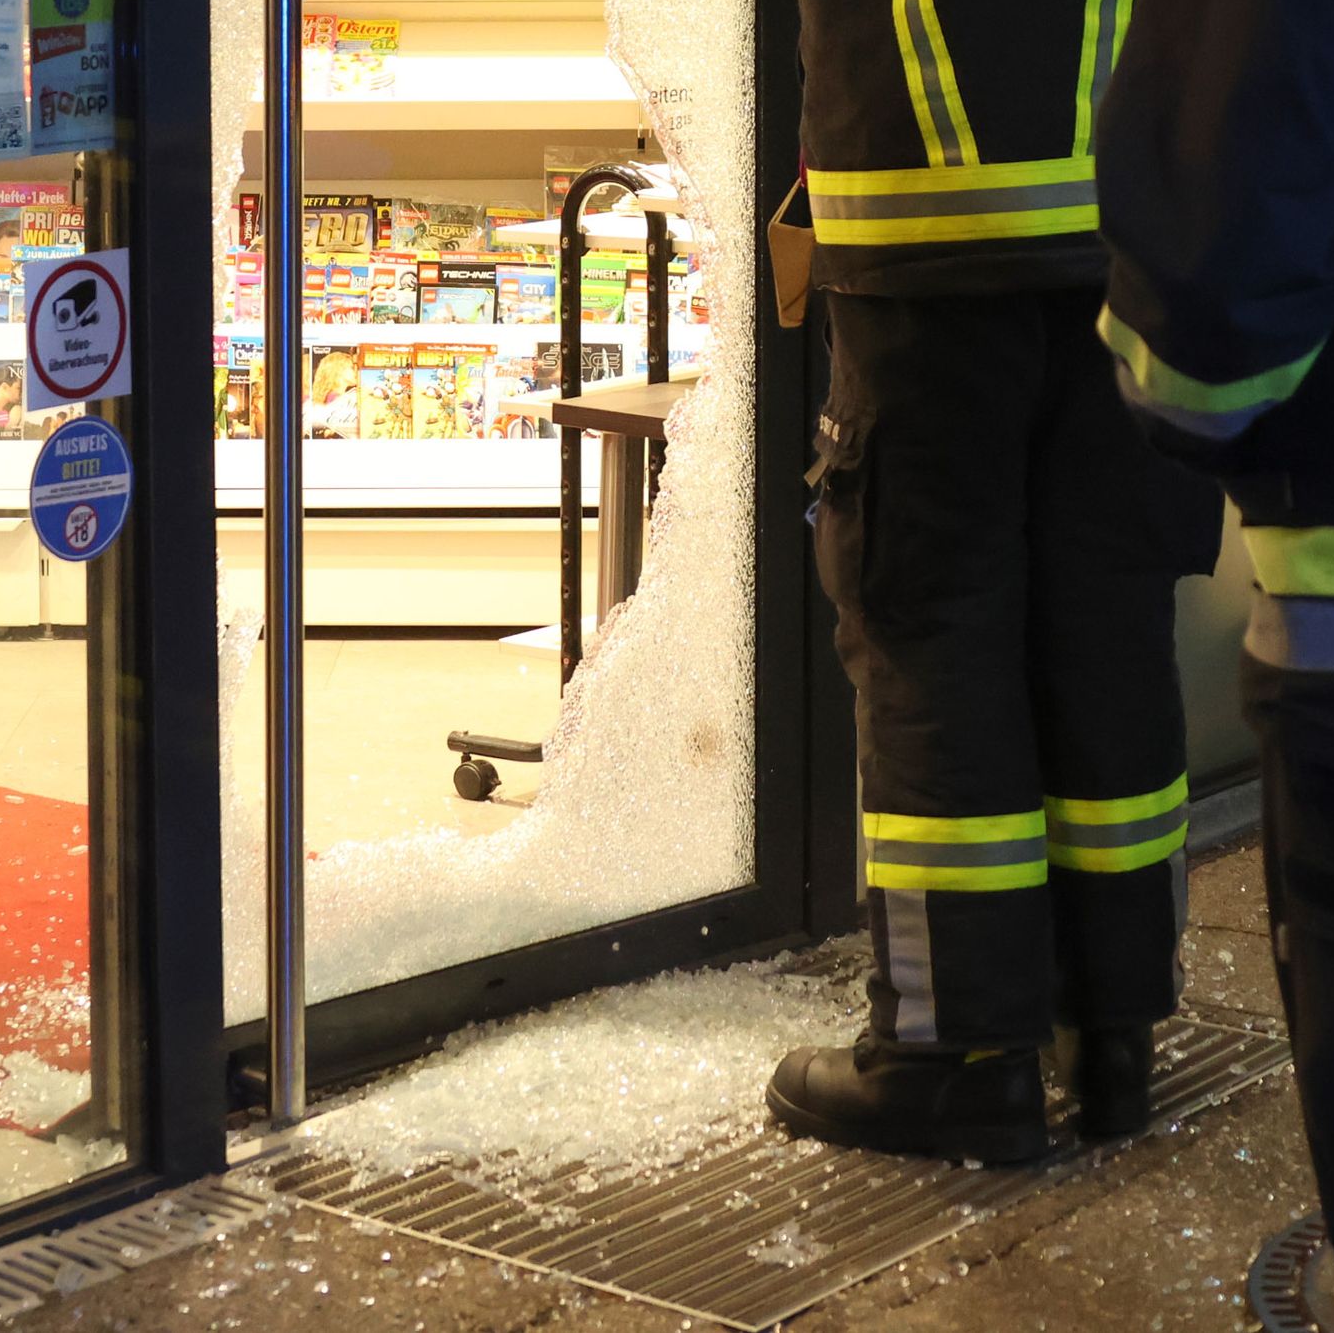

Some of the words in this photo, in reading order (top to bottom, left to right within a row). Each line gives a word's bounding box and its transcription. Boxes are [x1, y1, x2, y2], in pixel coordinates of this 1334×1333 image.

[337, 21, 396, 35] Ostern
[372, 40, 395, 50] 214
[80, 54, 110, 71] BON
[74, 94, 109, 118] APP
[326, 196, 346, 207] NR.
[345, 196, 354, 206] 7
[441, 269, 497, 281] TECHNIC
[522, 283, 547, 296] CITY
[54, 433, 108, 457] AUSWEIS
[61, 457, 101, 481] BITTE!
